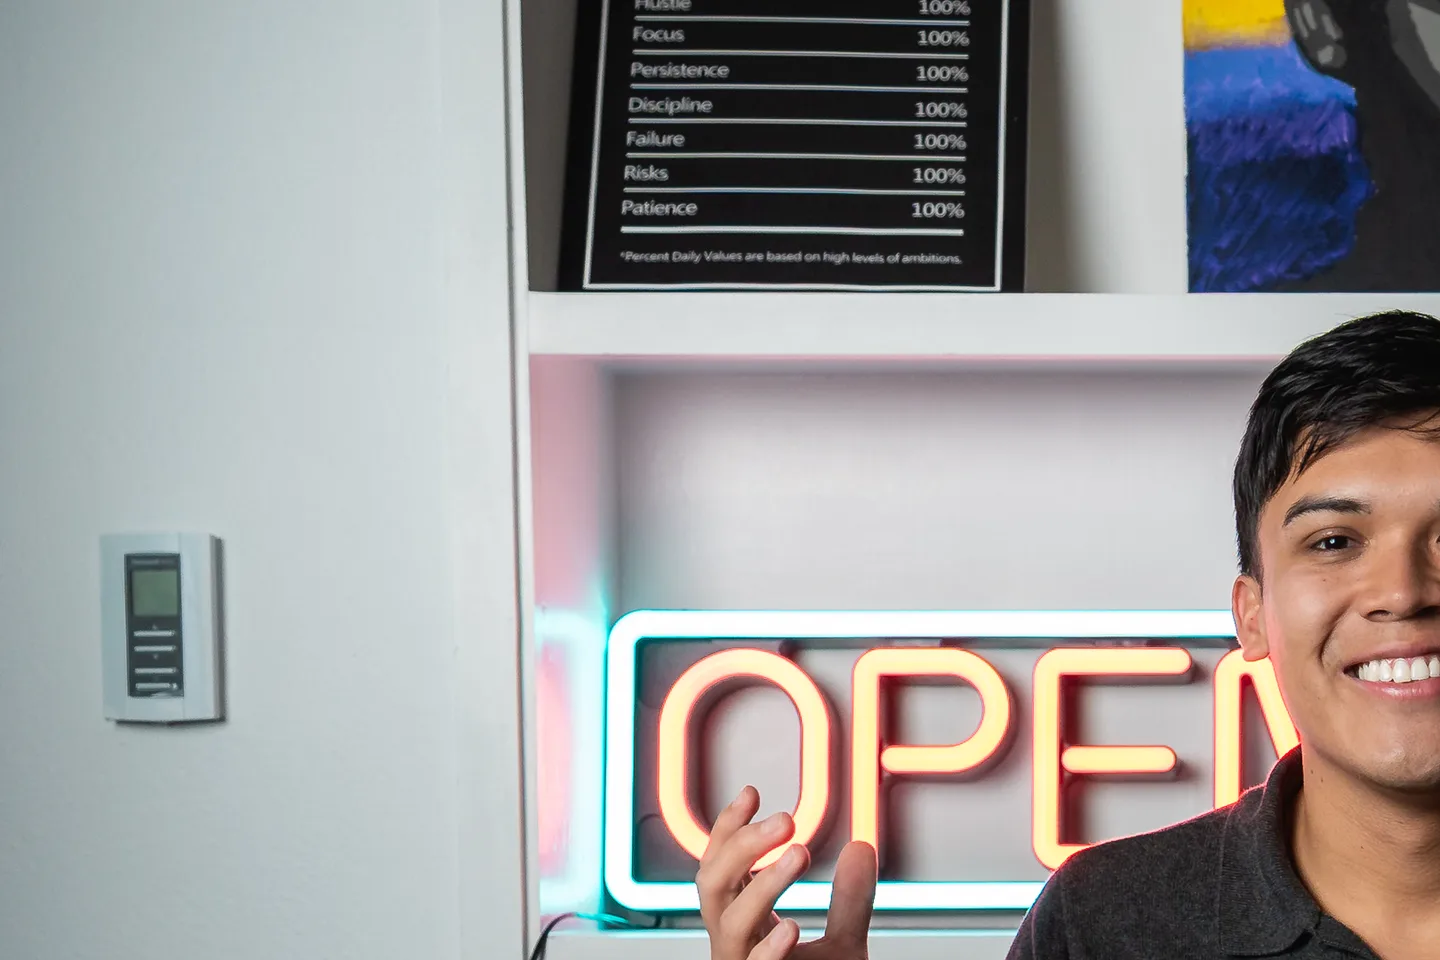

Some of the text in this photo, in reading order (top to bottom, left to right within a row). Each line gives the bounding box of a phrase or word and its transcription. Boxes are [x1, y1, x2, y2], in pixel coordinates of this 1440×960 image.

[635, 0, 971, 15] Hustle 100%
[633, 26, 969, 46] Focus 100%
[631, 62, 968, 81] Persistence 100%
[628, 97, 967, 118] Discipline 100%
[627, 131, 966, 149] Failure 100%
[624, 165, 966, 183] Risks 100%
[622, 200, 965, 218] Patience 100%
[672, 251, 702, 264] Daily
[704, 251, 743, 261] Values
[745, 253, 764, 262] are
[766, 251, 802, 262] based
[804, 253, 821, 262] on
[823, 252, 850, 265] high
[852, 253, 884, 263] levels
[886, 253, 900, 263] of
[902, 253, 961, 264] ambitions.
